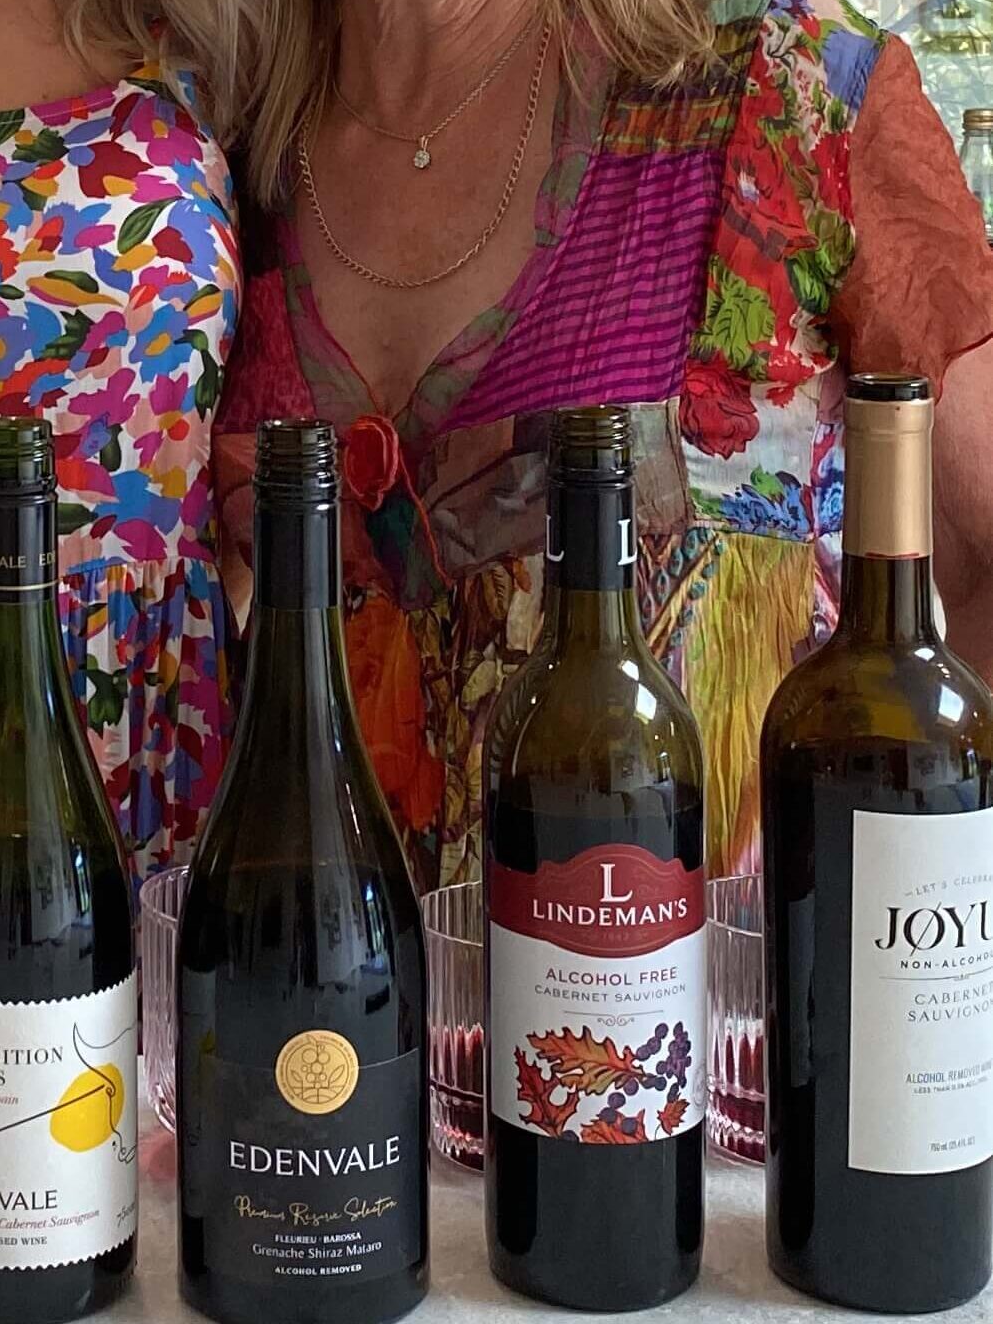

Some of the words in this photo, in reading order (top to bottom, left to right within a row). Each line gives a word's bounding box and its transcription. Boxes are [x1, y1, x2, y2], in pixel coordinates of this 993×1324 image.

[618, 518, 638, 566] L
[599, 863, 633, 903] L
[532, 897, 688, 926] LINDEMAN'S
[545, 967, 633, 986] ALCOHOL
[639, 966, 678, 984] FREE
[534, 984, 608, 1002] CABERNET
[614, 984, 686, 1003] SAUVIGNON
[907, 999, 993, 1022] SAUVIGNO
[906, 1072, 945, 1084] ALCOHOL
[229, 1135, 401, 1177] EDENVALE
[50, 1209, 100, 1228] Sauvignon
[21, 1236, 48, 1246] WINE
[274, 1234, 317, 1244] FLEURIEU
[323, 1232, 362, 1244] BAROSSA
[252, 1243, 305, 1260] Grenache
[308, 1247, 343, 1260] Shiraz
[346, 1241, 383, 1258] Mataro
[274, 1266, 318, 1276] ALCOHOL
[320, 1264, 362, 1276] REMOVED
